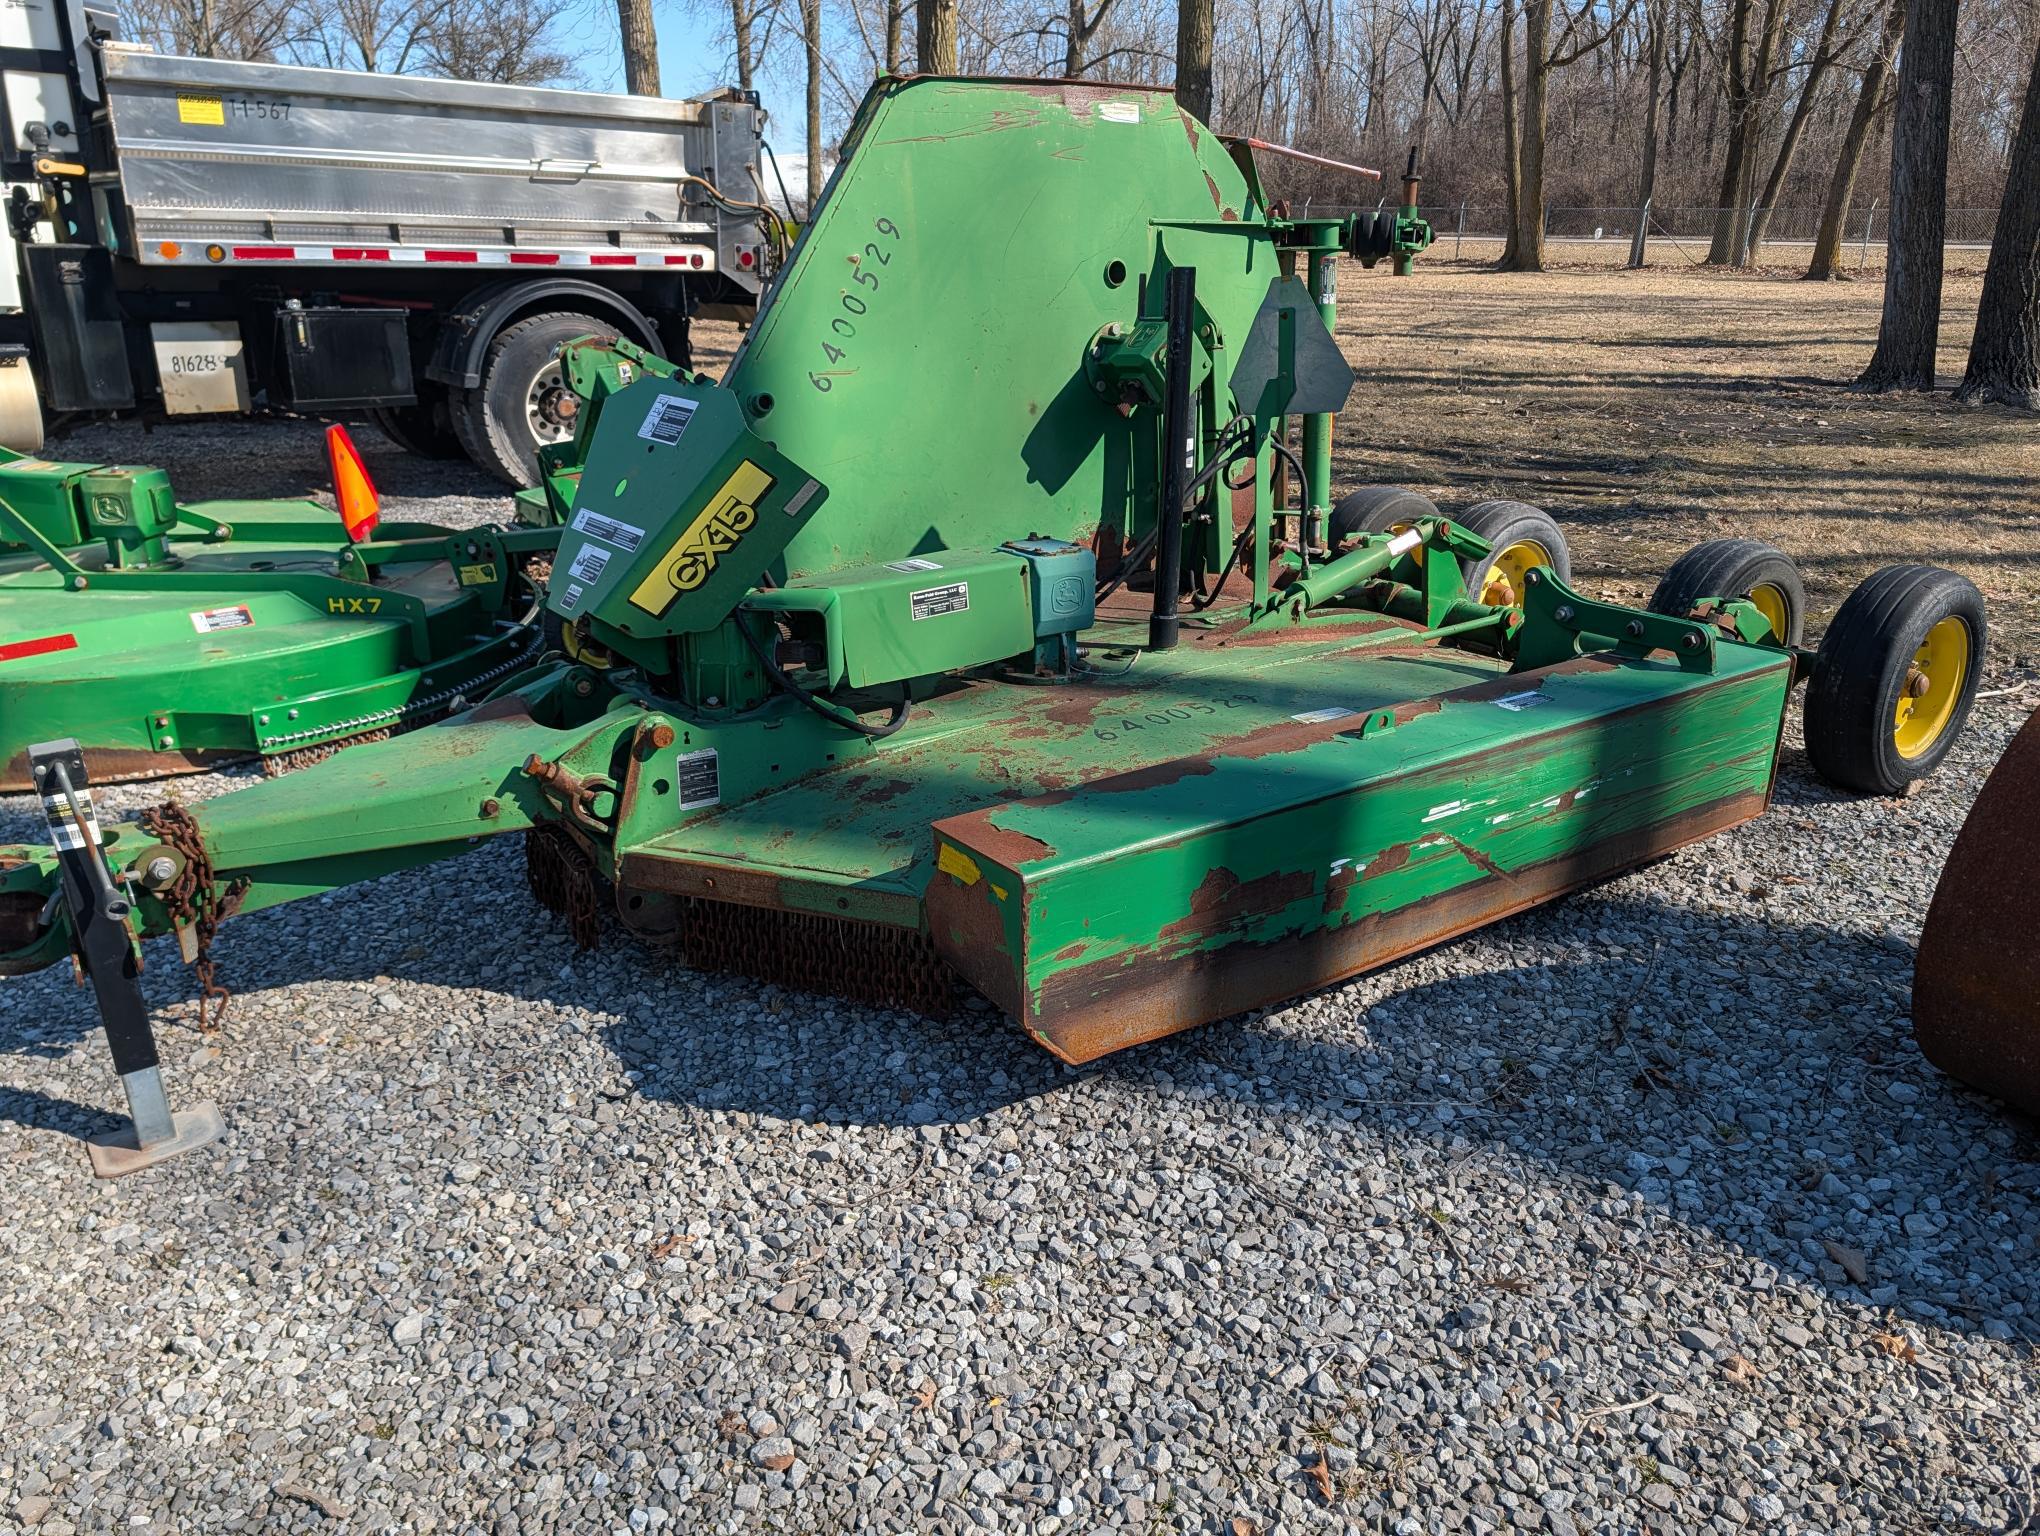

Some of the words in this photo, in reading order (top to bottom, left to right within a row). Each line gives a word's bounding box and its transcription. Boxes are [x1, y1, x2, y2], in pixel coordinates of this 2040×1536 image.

[809, 217, 900, 392] 6400529
[668, 495, 757, 591] CX15
[328, 597, 382, 613] HX7
[1094, 694, 1258, 741] 6400529
